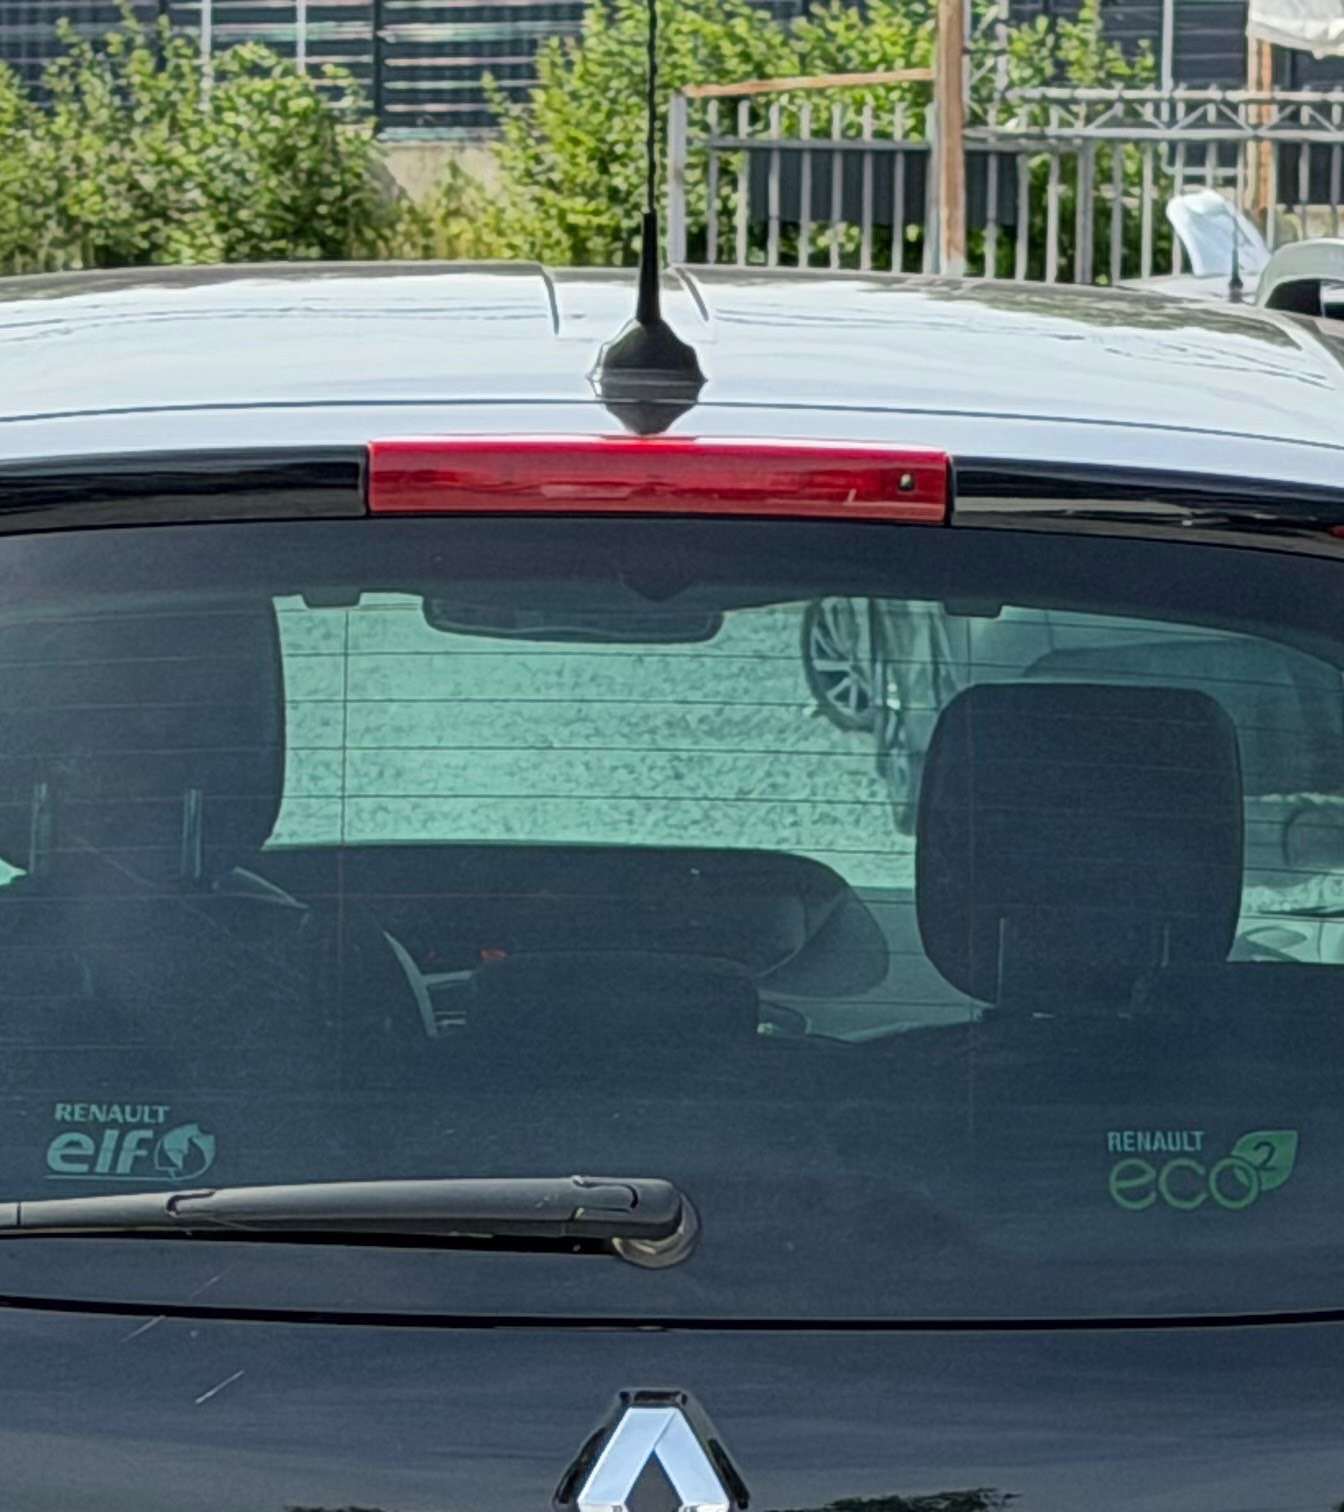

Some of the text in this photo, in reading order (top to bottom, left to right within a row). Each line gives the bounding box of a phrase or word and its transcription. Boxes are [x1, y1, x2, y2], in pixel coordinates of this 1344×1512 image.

[54, 1103, 170, 1123] RENAULT
[46, 1129, 154, 1174] elf
[1107, 1130, 1204, 1152] RENAULT
